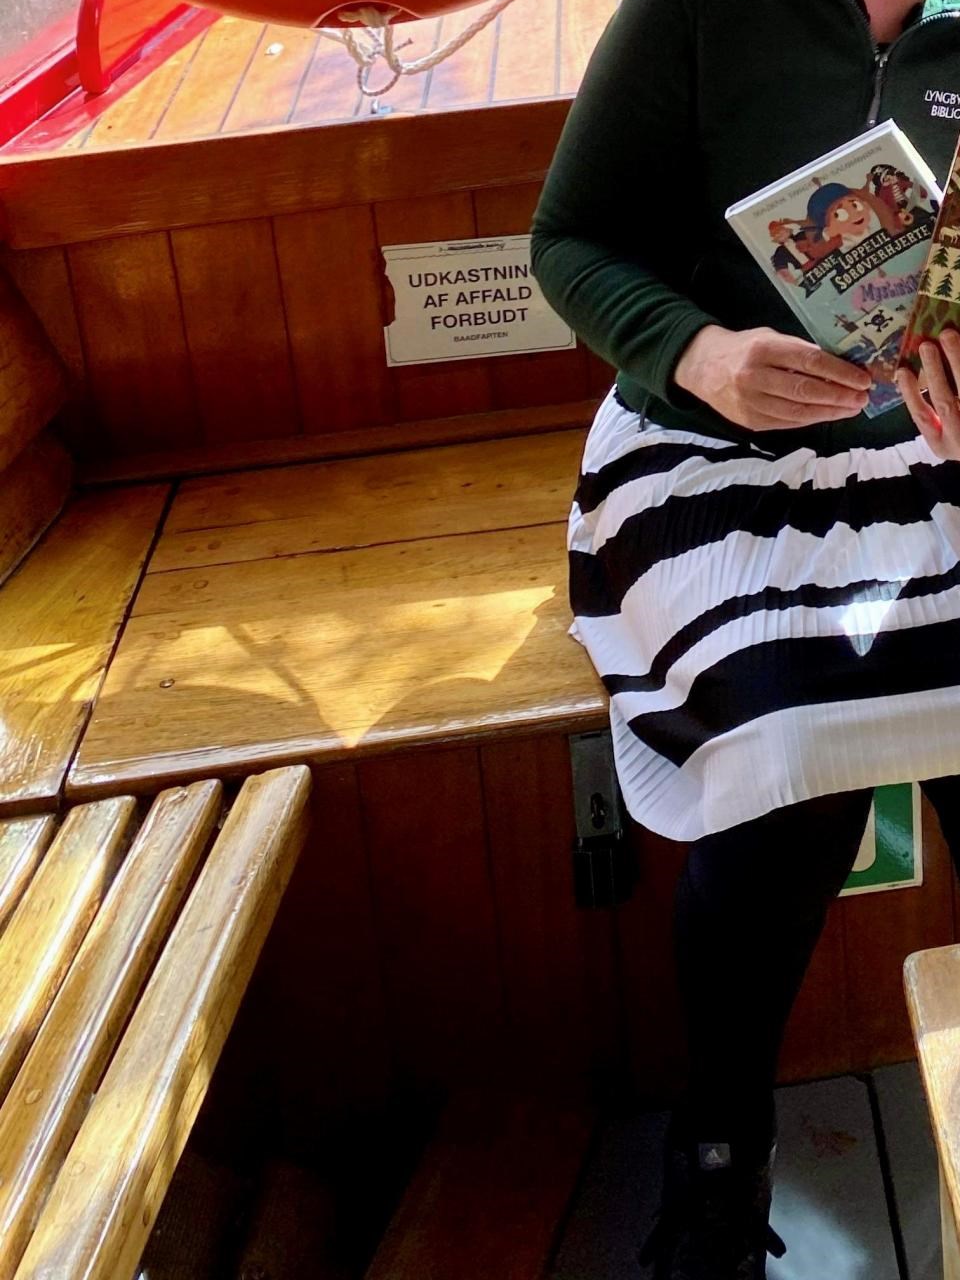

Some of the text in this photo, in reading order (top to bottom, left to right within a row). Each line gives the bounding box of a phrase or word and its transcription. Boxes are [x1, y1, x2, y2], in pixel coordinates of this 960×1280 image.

[838, 231, 891, 270] LOPPELIL
[408, 264, 529, 288] UDKASTNIN
[424, 286, 532, 309] AF AFFALD
[431, 308, 529, 330] FORBUDT
